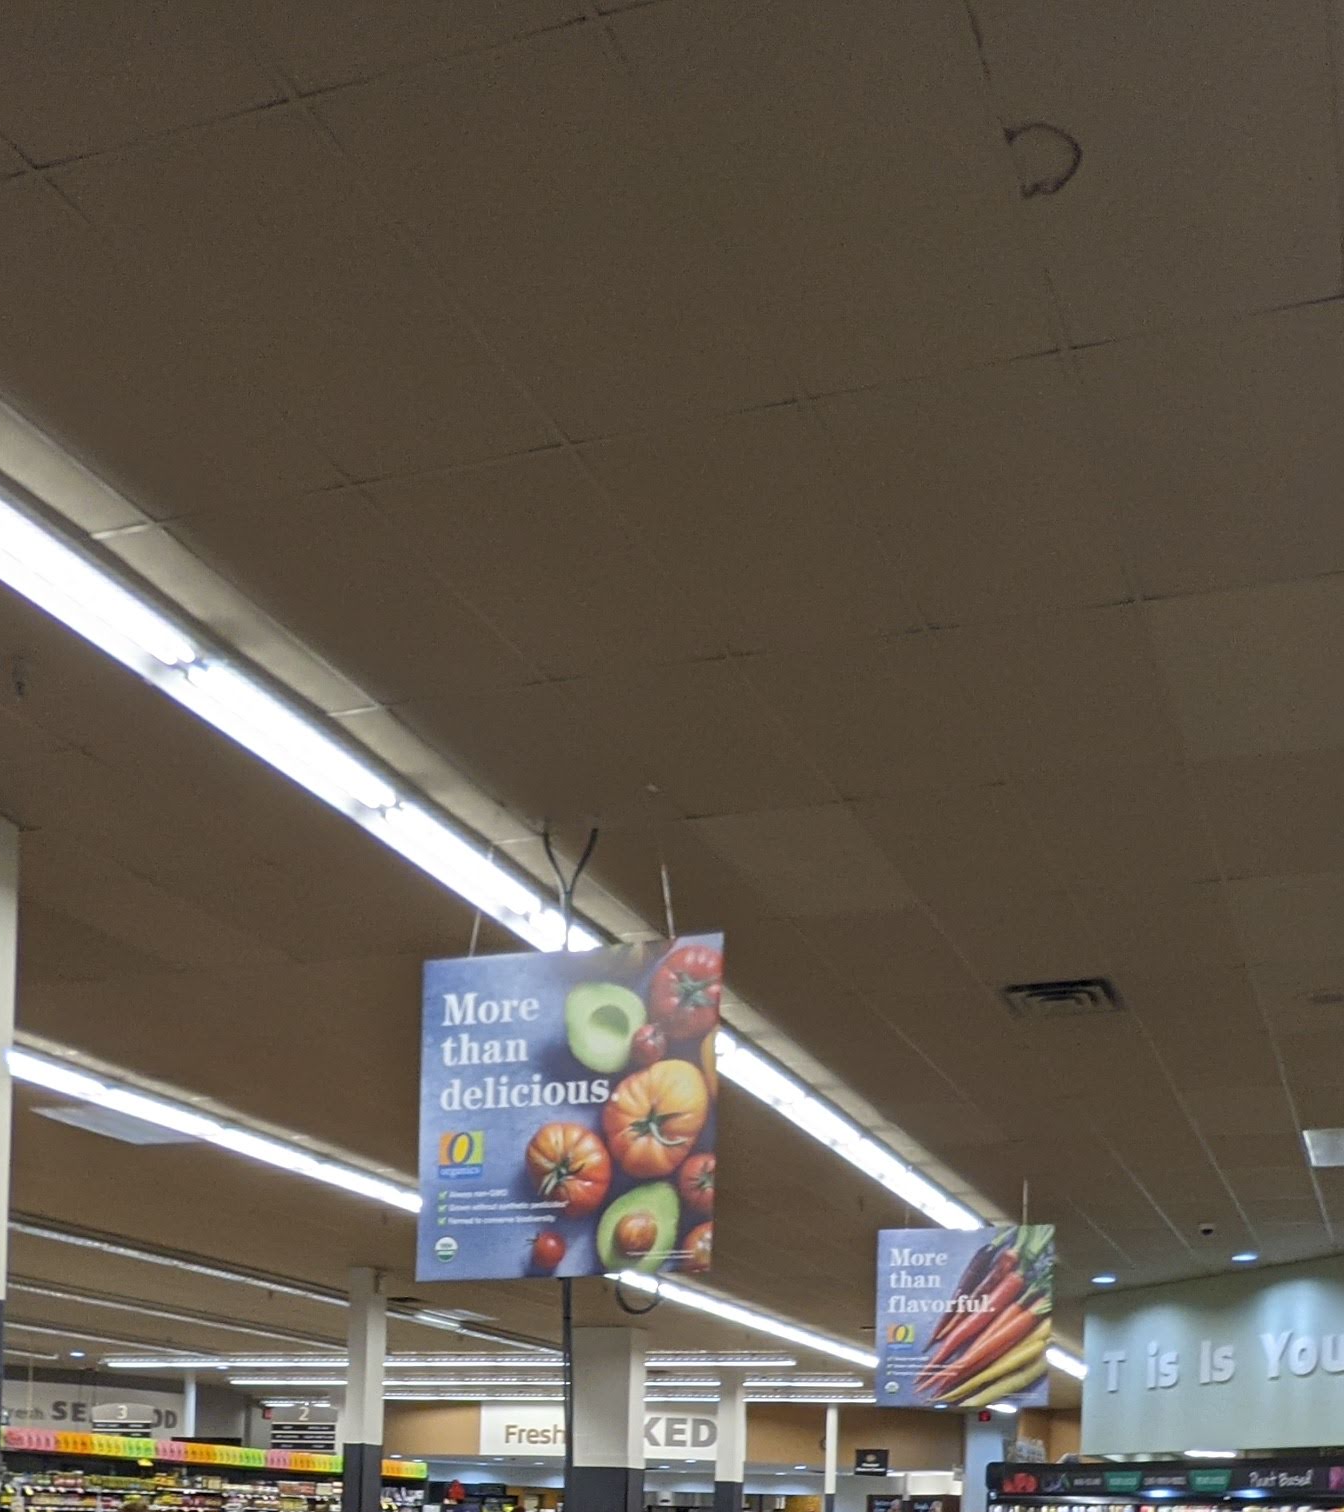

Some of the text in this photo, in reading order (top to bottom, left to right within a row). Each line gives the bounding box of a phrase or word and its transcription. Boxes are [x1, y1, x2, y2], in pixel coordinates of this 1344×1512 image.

[441, 992, 539, 1027] More
[441, 1033, 529, 1066] than
[441, 1074, 620, 1111] delicious.
[889, 1248, 948, 1267] More
[889, 1270, 941, 1289] than
[887, 1294, 996, 1313] flavorful.
[1200, 1339, 1235, 1386] Is
[117, 1405, 128, 1420] 3
[298, 1406, 310, 1421] 2
[505, 1416, 719, 1448] Fresh KED
